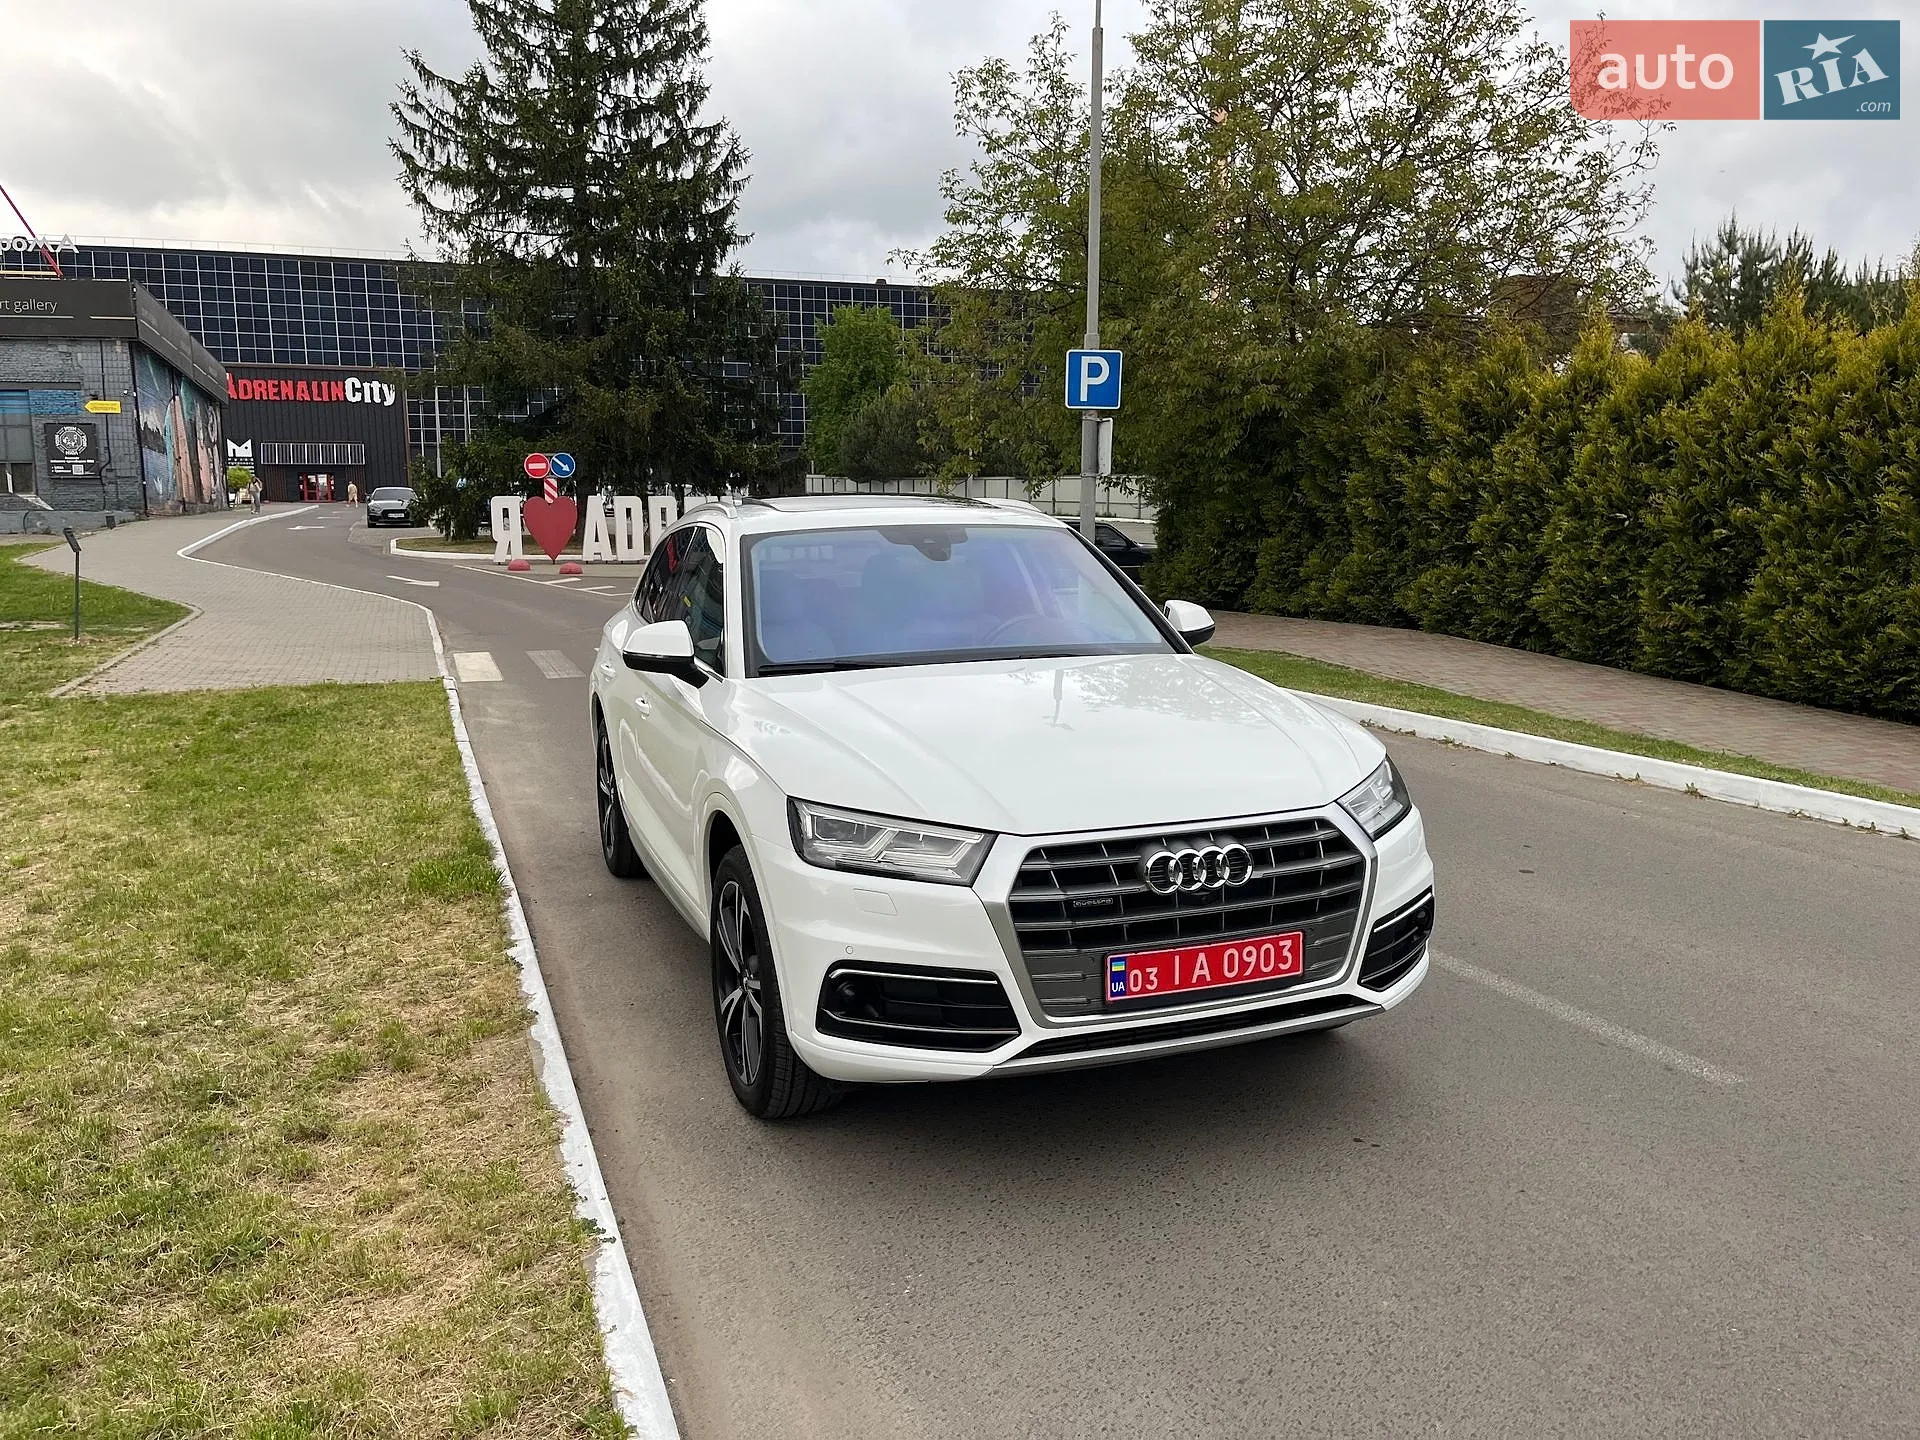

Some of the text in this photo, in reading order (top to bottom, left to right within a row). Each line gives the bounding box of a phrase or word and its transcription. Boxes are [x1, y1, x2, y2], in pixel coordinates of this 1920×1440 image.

[13, 298, 58, 314] gallery
[1080, 356, 1110, 402] P
[1128, 966, 1159, 993] 03
[1222, 939, 1293, 979] 0903
[1111, 981, 1126, 993] UA
